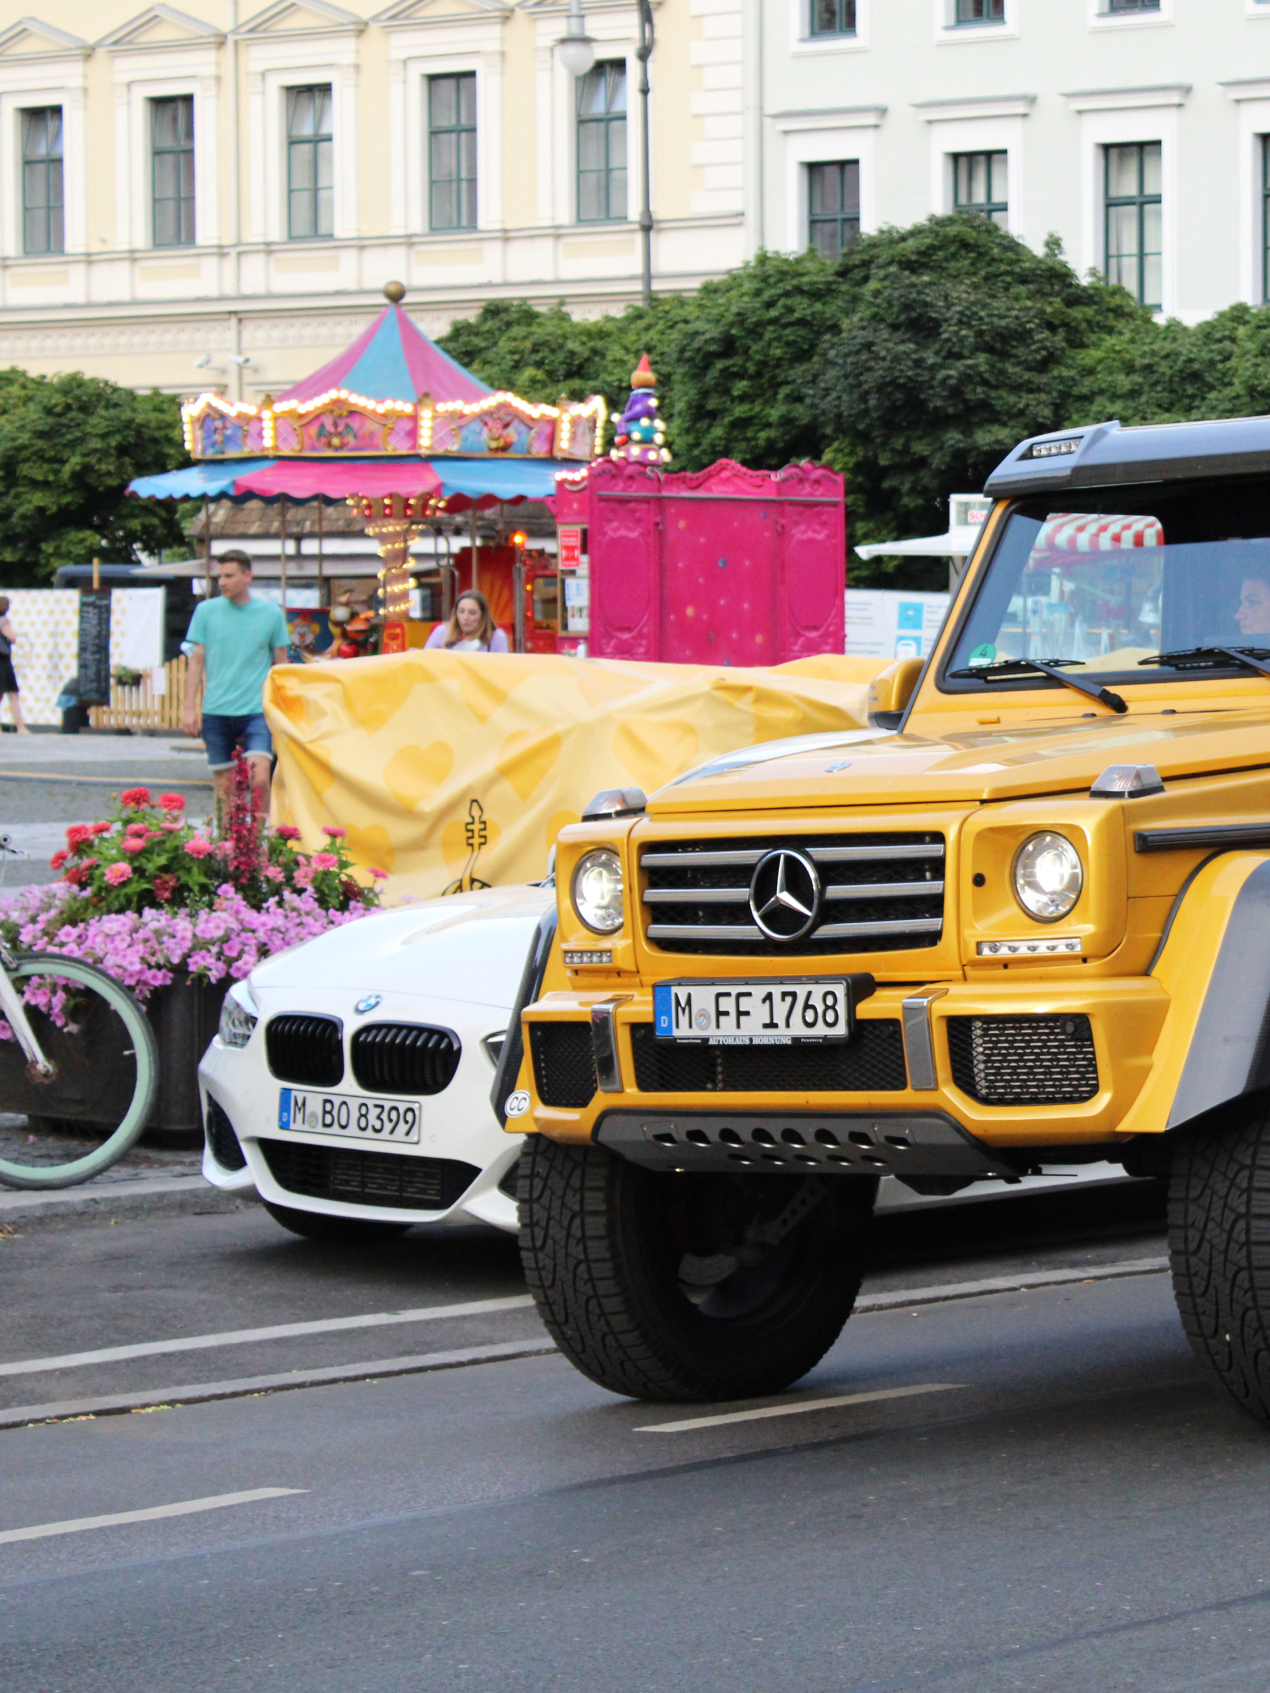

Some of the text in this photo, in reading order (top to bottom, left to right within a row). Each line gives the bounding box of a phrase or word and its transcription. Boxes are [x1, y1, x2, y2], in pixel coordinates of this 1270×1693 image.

[979, 644, 989, 657] 4
[674, 990, 839, 1029] M FF 1768
[660, 1016, 669, 1028] D
[708, 1036, 750, 1045] AUTOHAUS
[752, 1036, 792, 1045] HORNUNG
[509, 1096, 528, 1112] CC
[282, 1112, 288, 1122] D
[293, 1094, 417, 1137] M BO 8399
